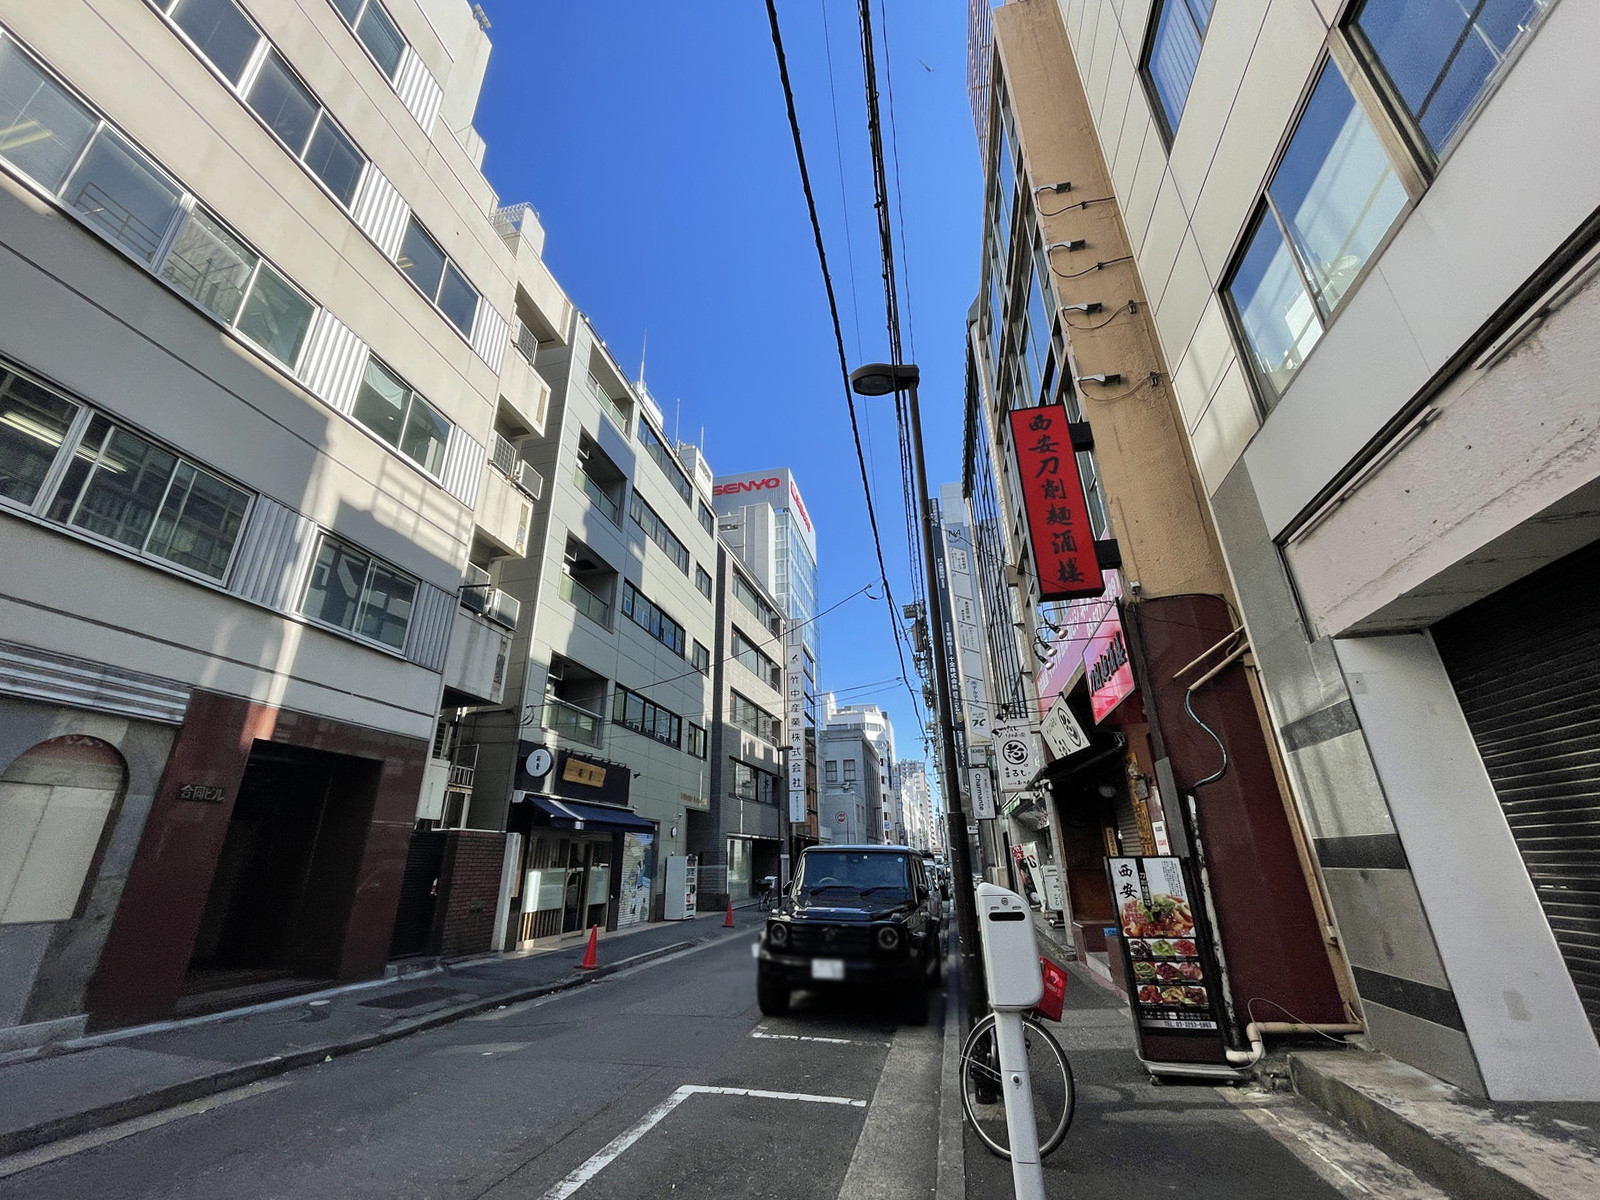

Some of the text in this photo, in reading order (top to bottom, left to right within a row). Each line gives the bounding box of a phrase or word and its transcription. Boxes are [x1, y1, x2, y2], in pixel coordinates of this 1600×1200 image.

[713, 477, 780, 497] SENYO
[790, 675, 802, 788] 竹中産業株式会社
[180, 784, 225, 802] 合同ビル
[974, 773, 985, 811] Charmante
[1118, 864, 1138, 899] 西安
